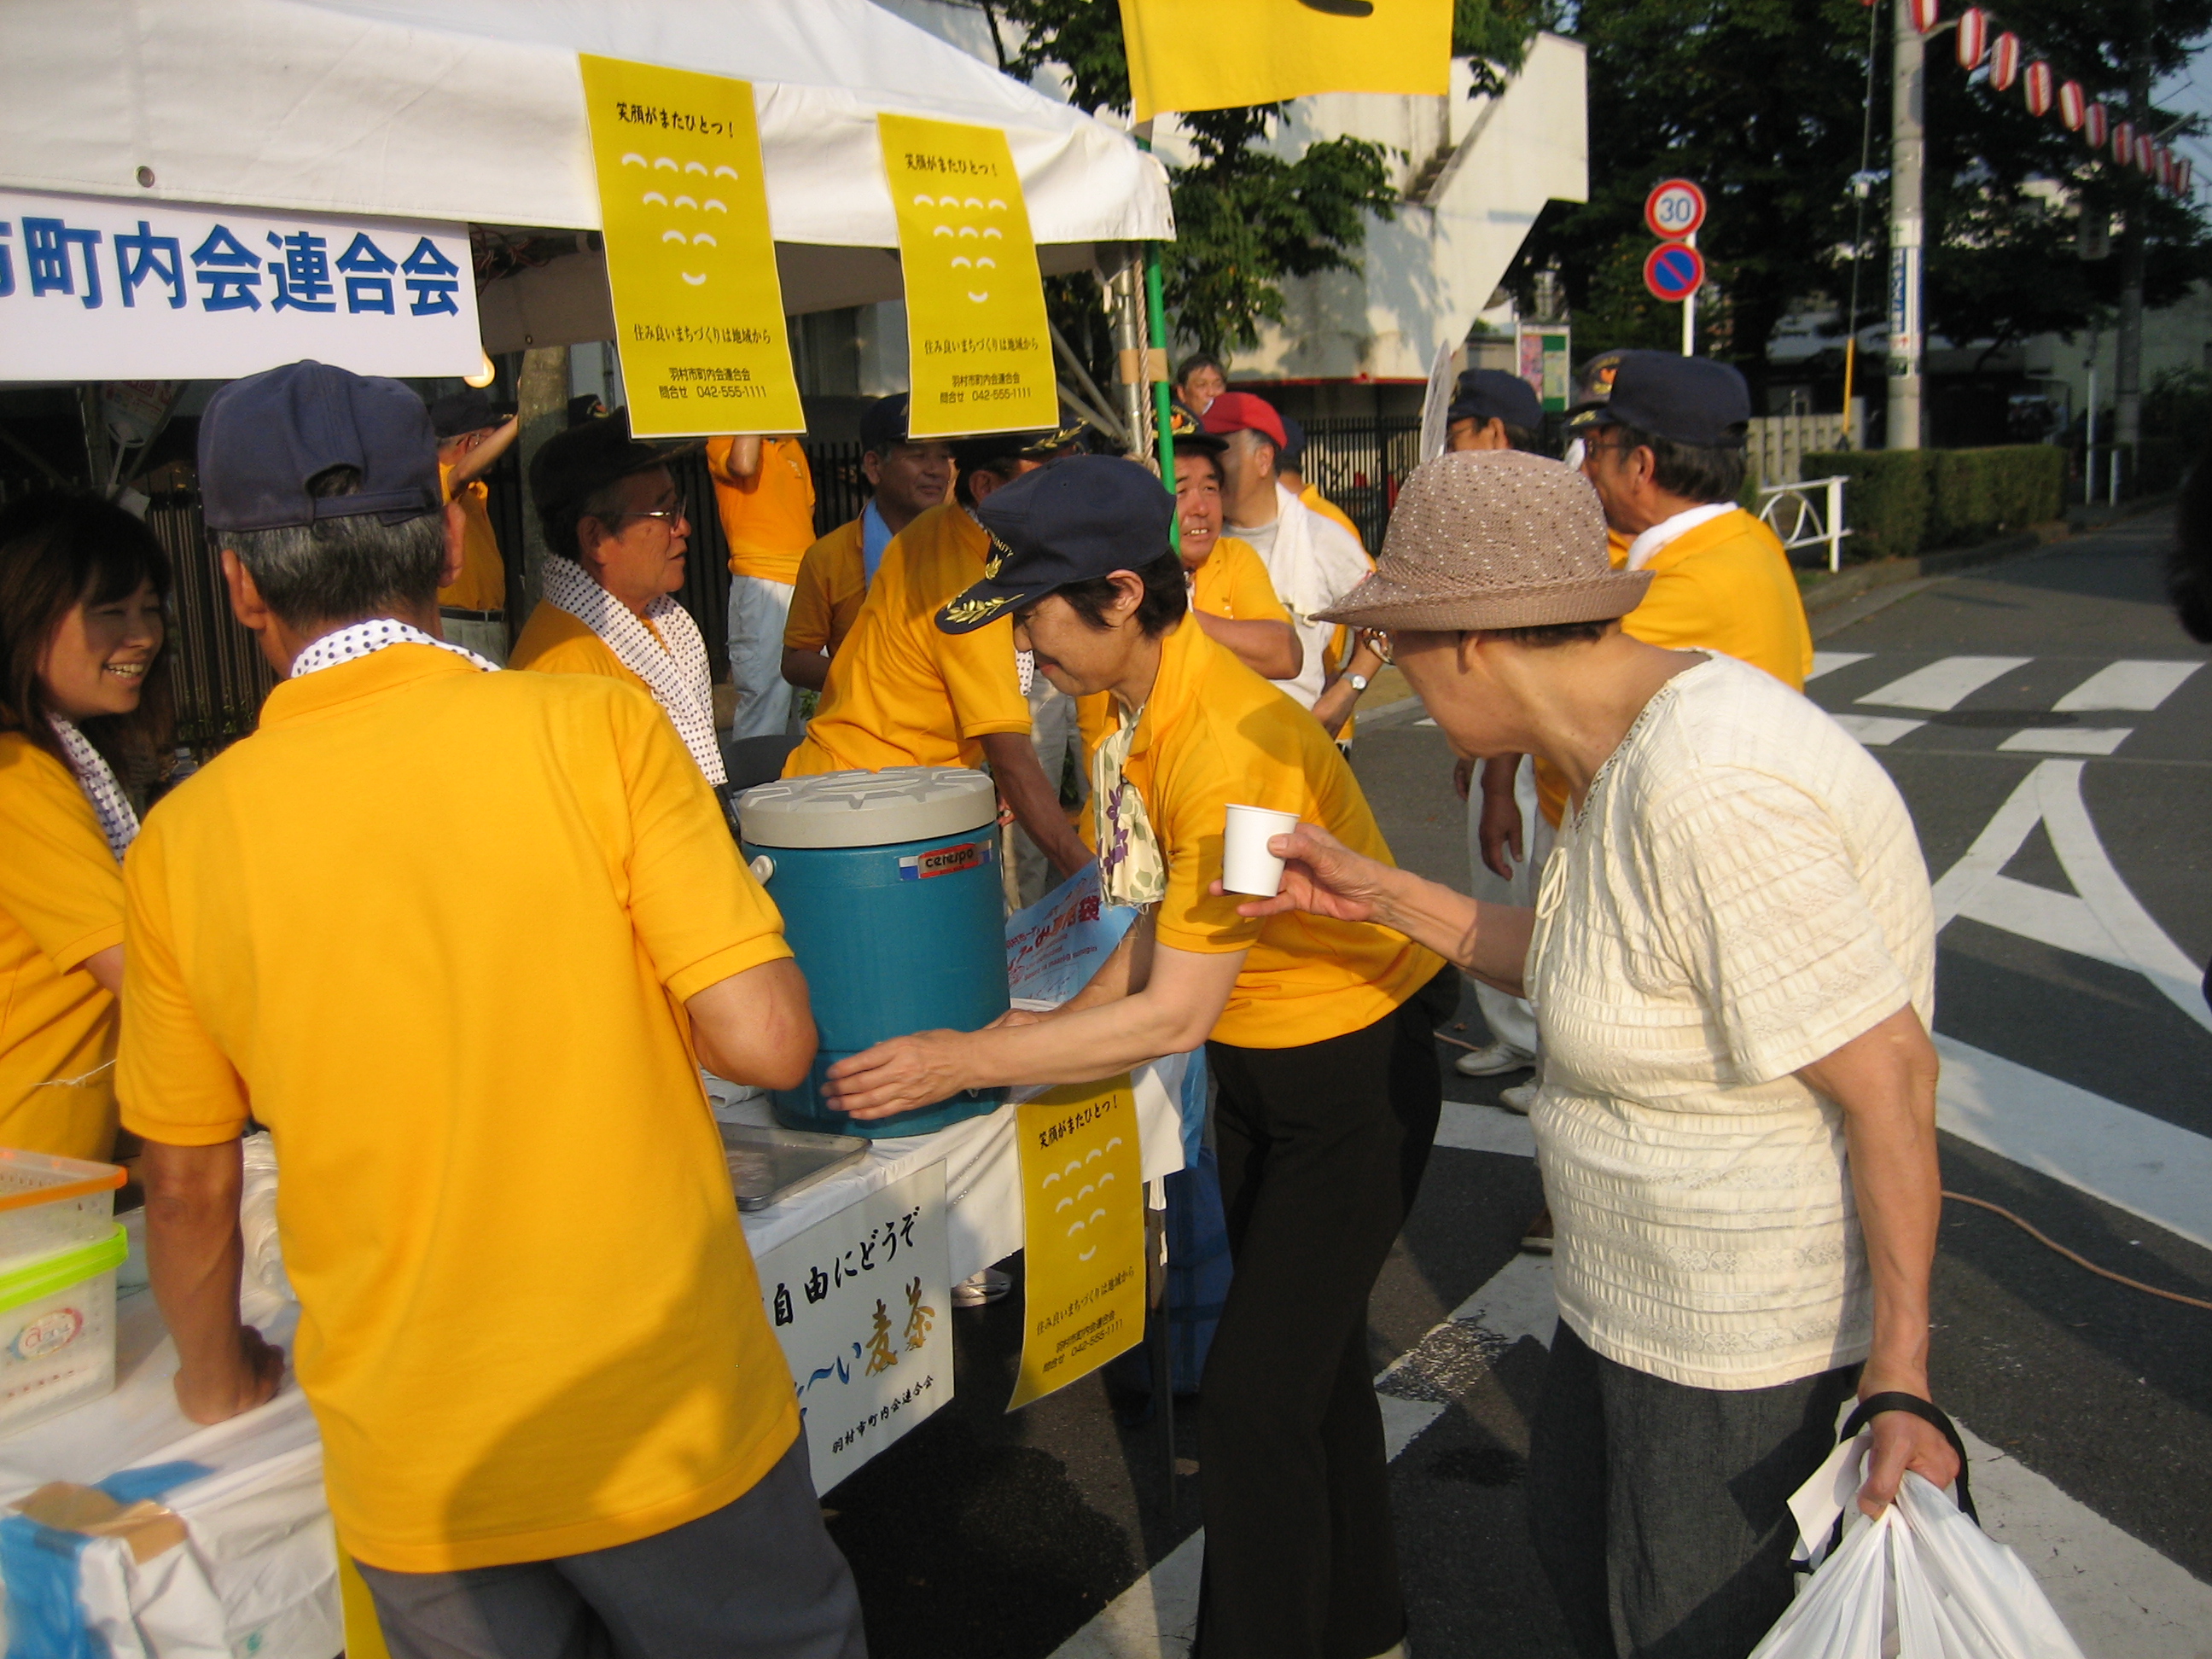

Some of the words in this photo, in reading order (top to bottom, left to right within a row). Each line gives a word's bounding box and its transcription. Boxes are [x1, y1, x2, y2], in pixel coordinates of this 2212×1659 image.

[1660, 197, 1691, 223] 30
[0, 216, 461, 318] 町内会連合会
[696, 385, 767, 399] 042-555-1111
[972, 387, 1032, 401] 042-555-1111
[771, 1206, 921, 1327] 自由にどうぞ
[1071, 1318, 1123, 1357] 042-555-1111
